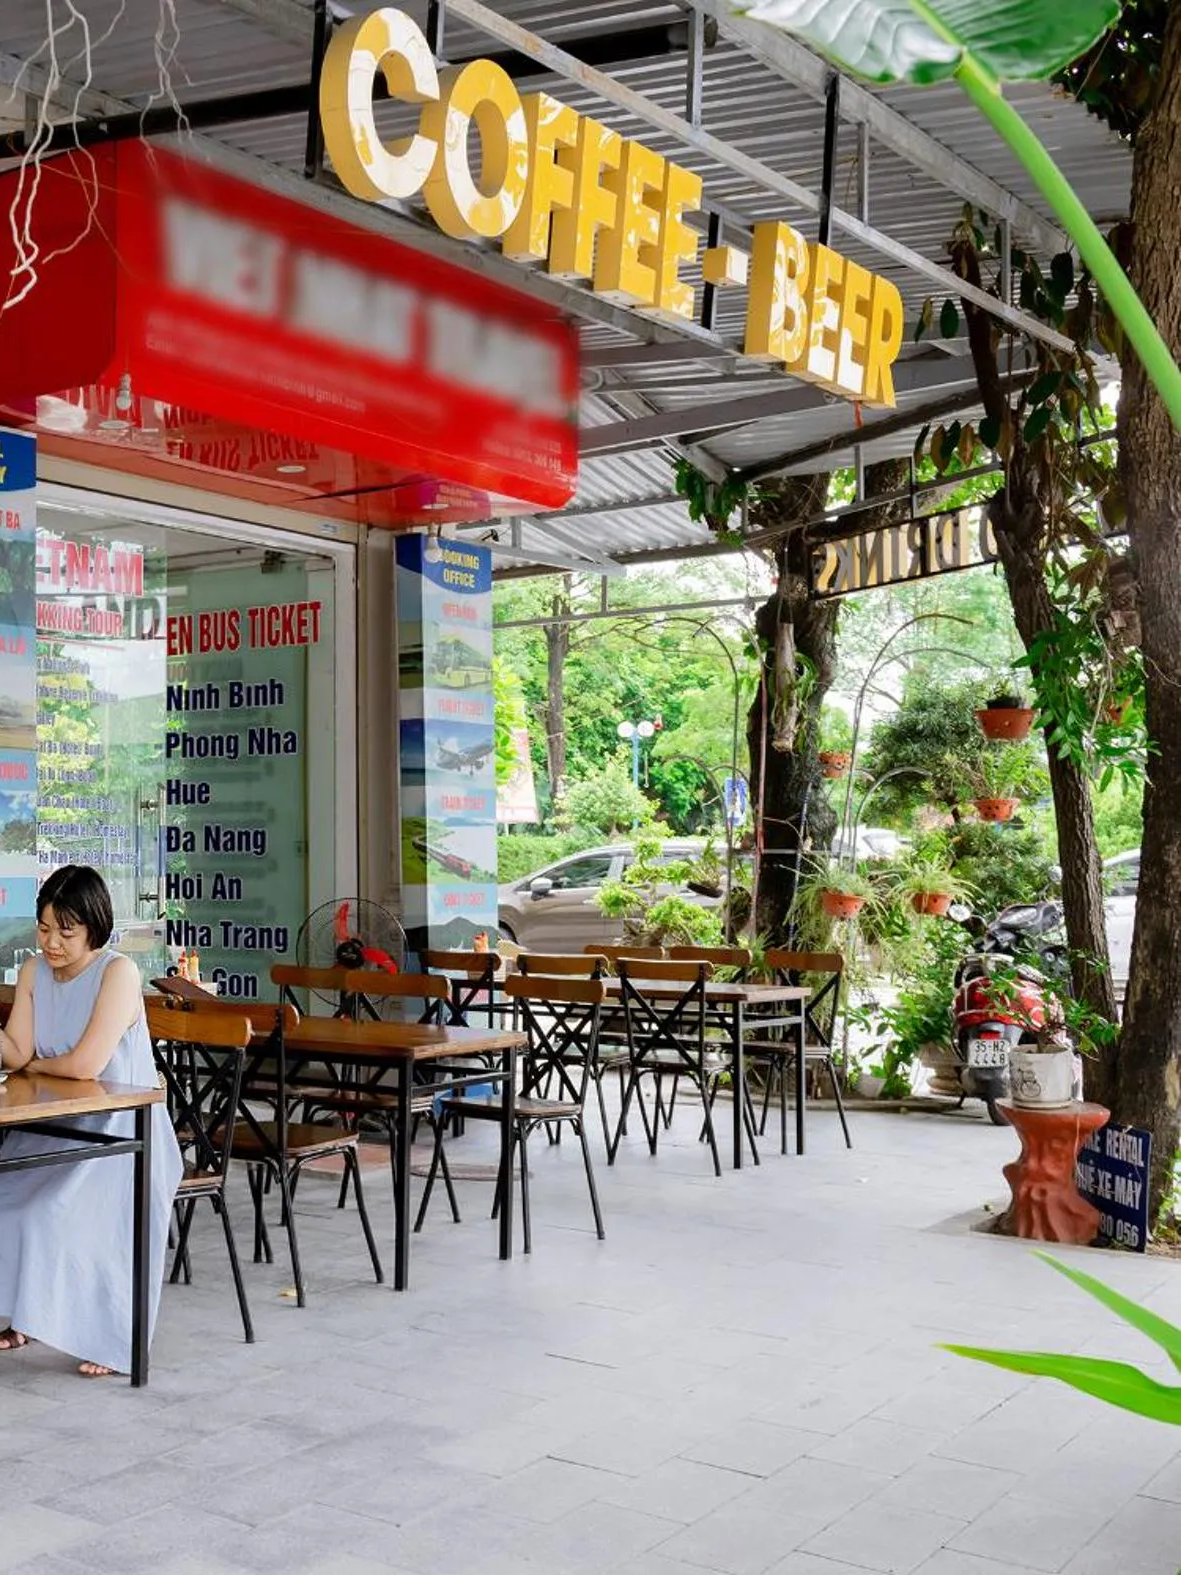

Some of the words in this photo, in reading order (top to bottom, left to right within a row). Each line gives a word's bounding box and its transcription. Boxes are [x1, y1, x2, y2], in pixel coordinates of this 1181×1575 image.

[321, 7, 703, 320] COFFEE
[745, 220, 904, 409] BEER
[6, 508, 22, 529] BA
[443, 568, 475, 588] OFFICE
[85, 607, 123, 637] TOUR
[198, 609, 242, 653] BUS
[248, 601, 323, 648] TICKET
[166, 683, 220, 711] Ninh
[229, 679, 284, 708] Binh
[166, 732, 239, 759] Phong
[248, 727, 297, 755] Nha
[165, 779, 211, 805] Hue
[165, 825, 196, 852] Đa
[204, 825, 267, 856] Nang
[165, 872, 203, 900] Hoi
[210, 872, 242, 900] An
[165, 919, 212, 947] Nha
[220, 921, 289, 953] Trang
[1106, 1128, 1145, 1167] RENTAL
[1097, 1169, 1112, 1200] XE
[1114, 1173, 1142, 1210] MÁY
[1116, 1219, 1140, 1247] 056
